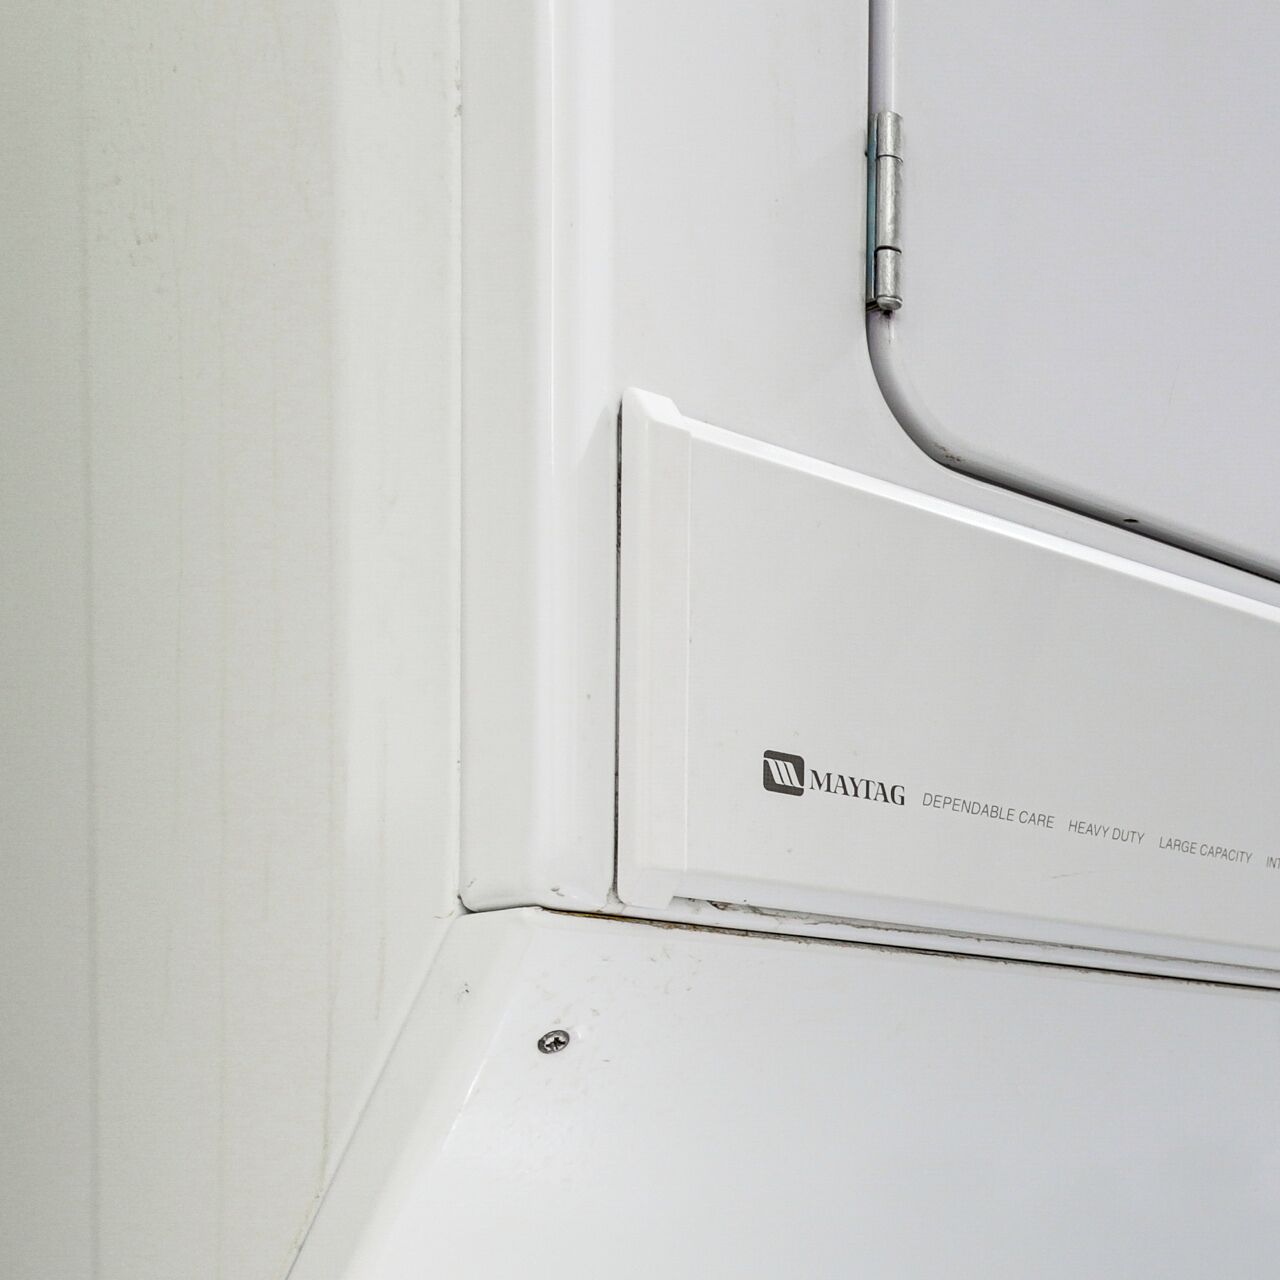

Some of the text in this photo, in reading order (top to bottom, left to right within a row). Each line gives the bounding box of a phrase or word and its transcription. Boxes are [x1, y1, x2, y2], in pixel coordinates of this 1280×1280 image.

[809, 769, 906, 806] MAYTAG
[922, 792, 1056, 829] DEPENDABLE CARE
[1068, 820, 1146, 845] HEAVY DUTY
[1159, 836, 1254, 865] LARGE CAPACITY
